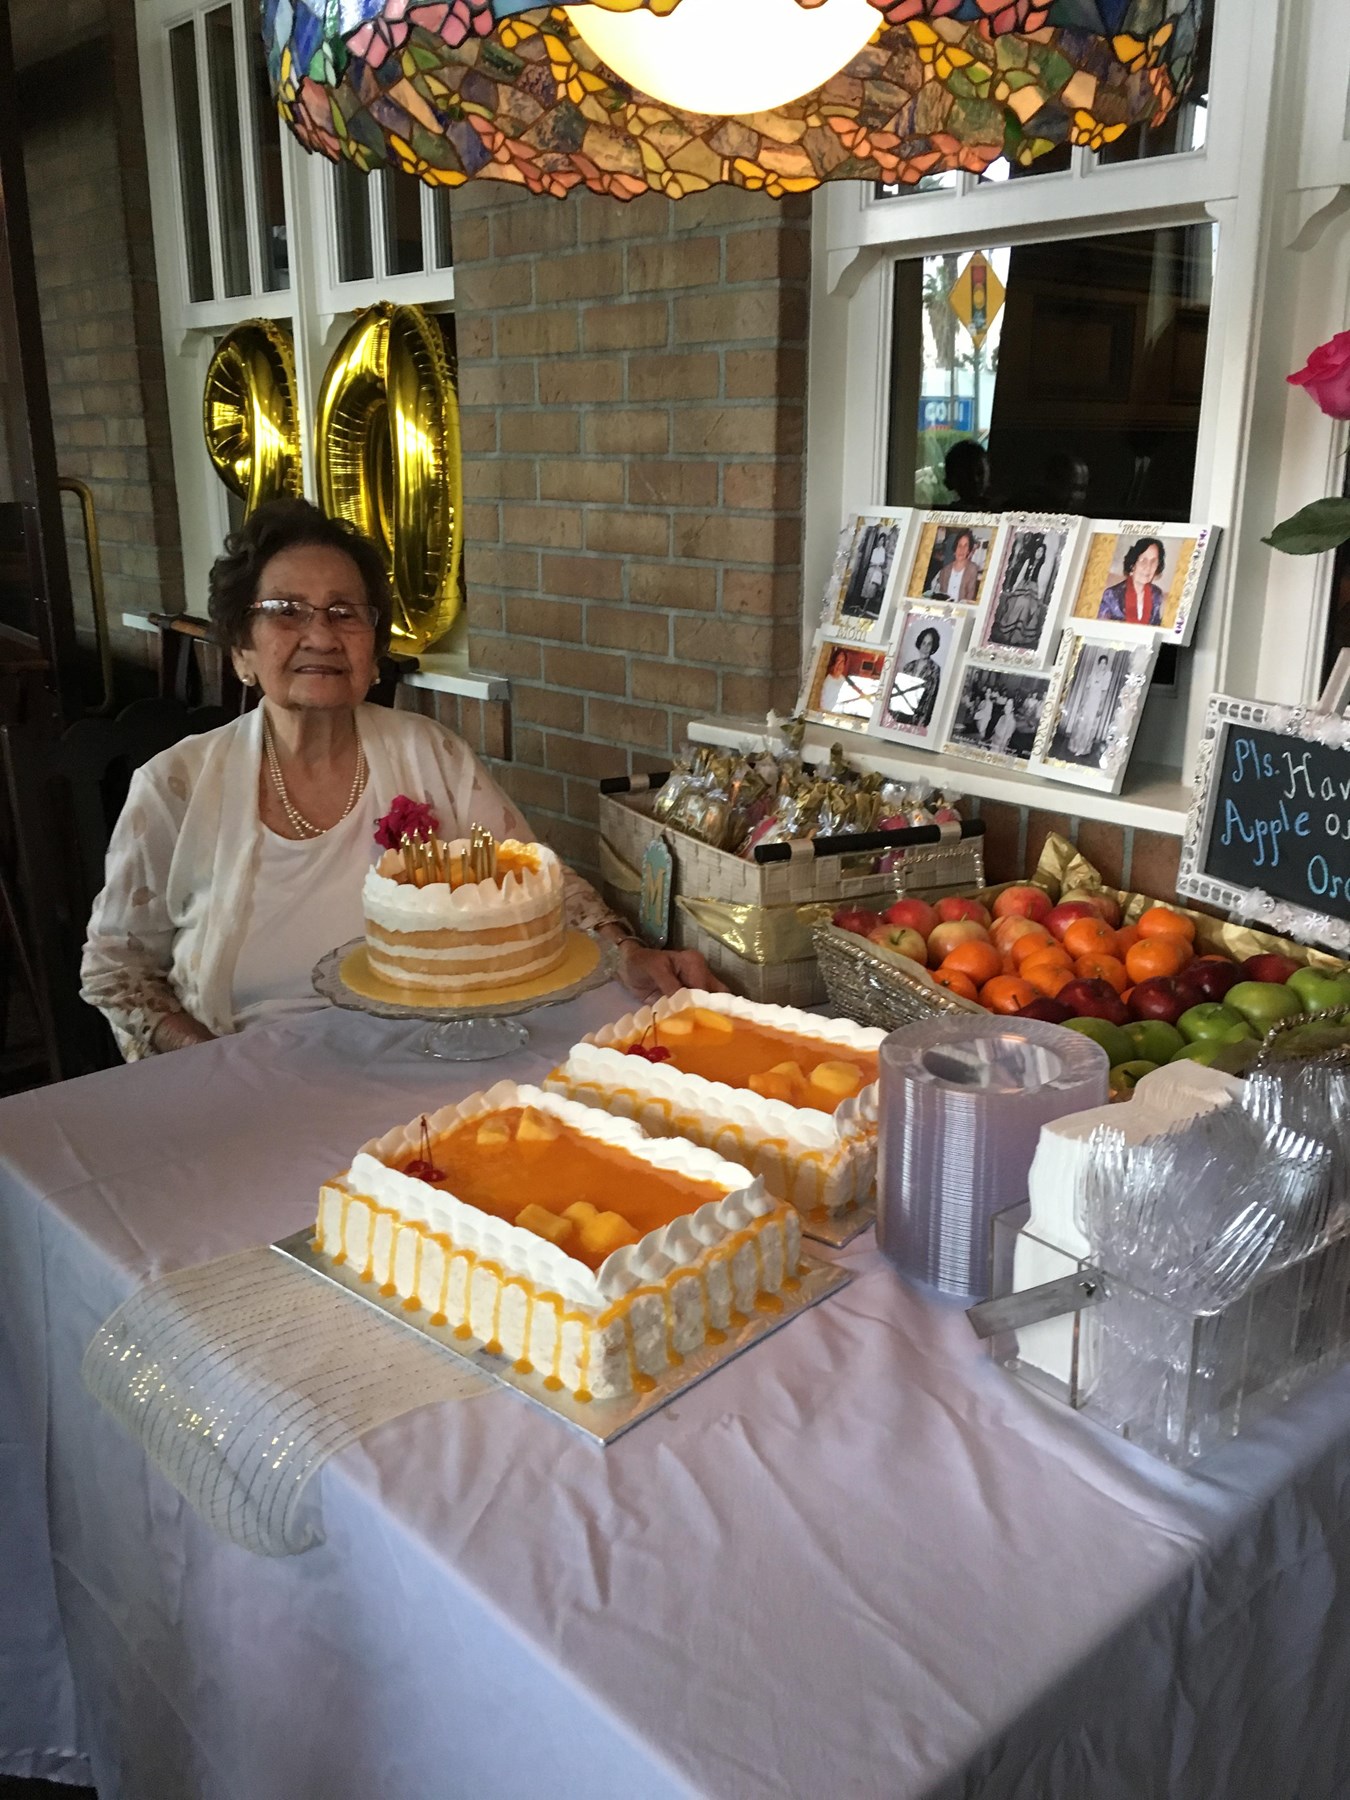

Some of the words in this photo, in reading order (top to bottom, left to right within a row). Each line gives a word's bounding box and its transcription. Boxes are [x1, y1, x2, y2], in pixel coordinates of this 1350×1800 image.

[1232, 738, 1280, 783] Pls.
[1221, 798, 1311, 867] Apple
[644, 862, 666, 927] M
